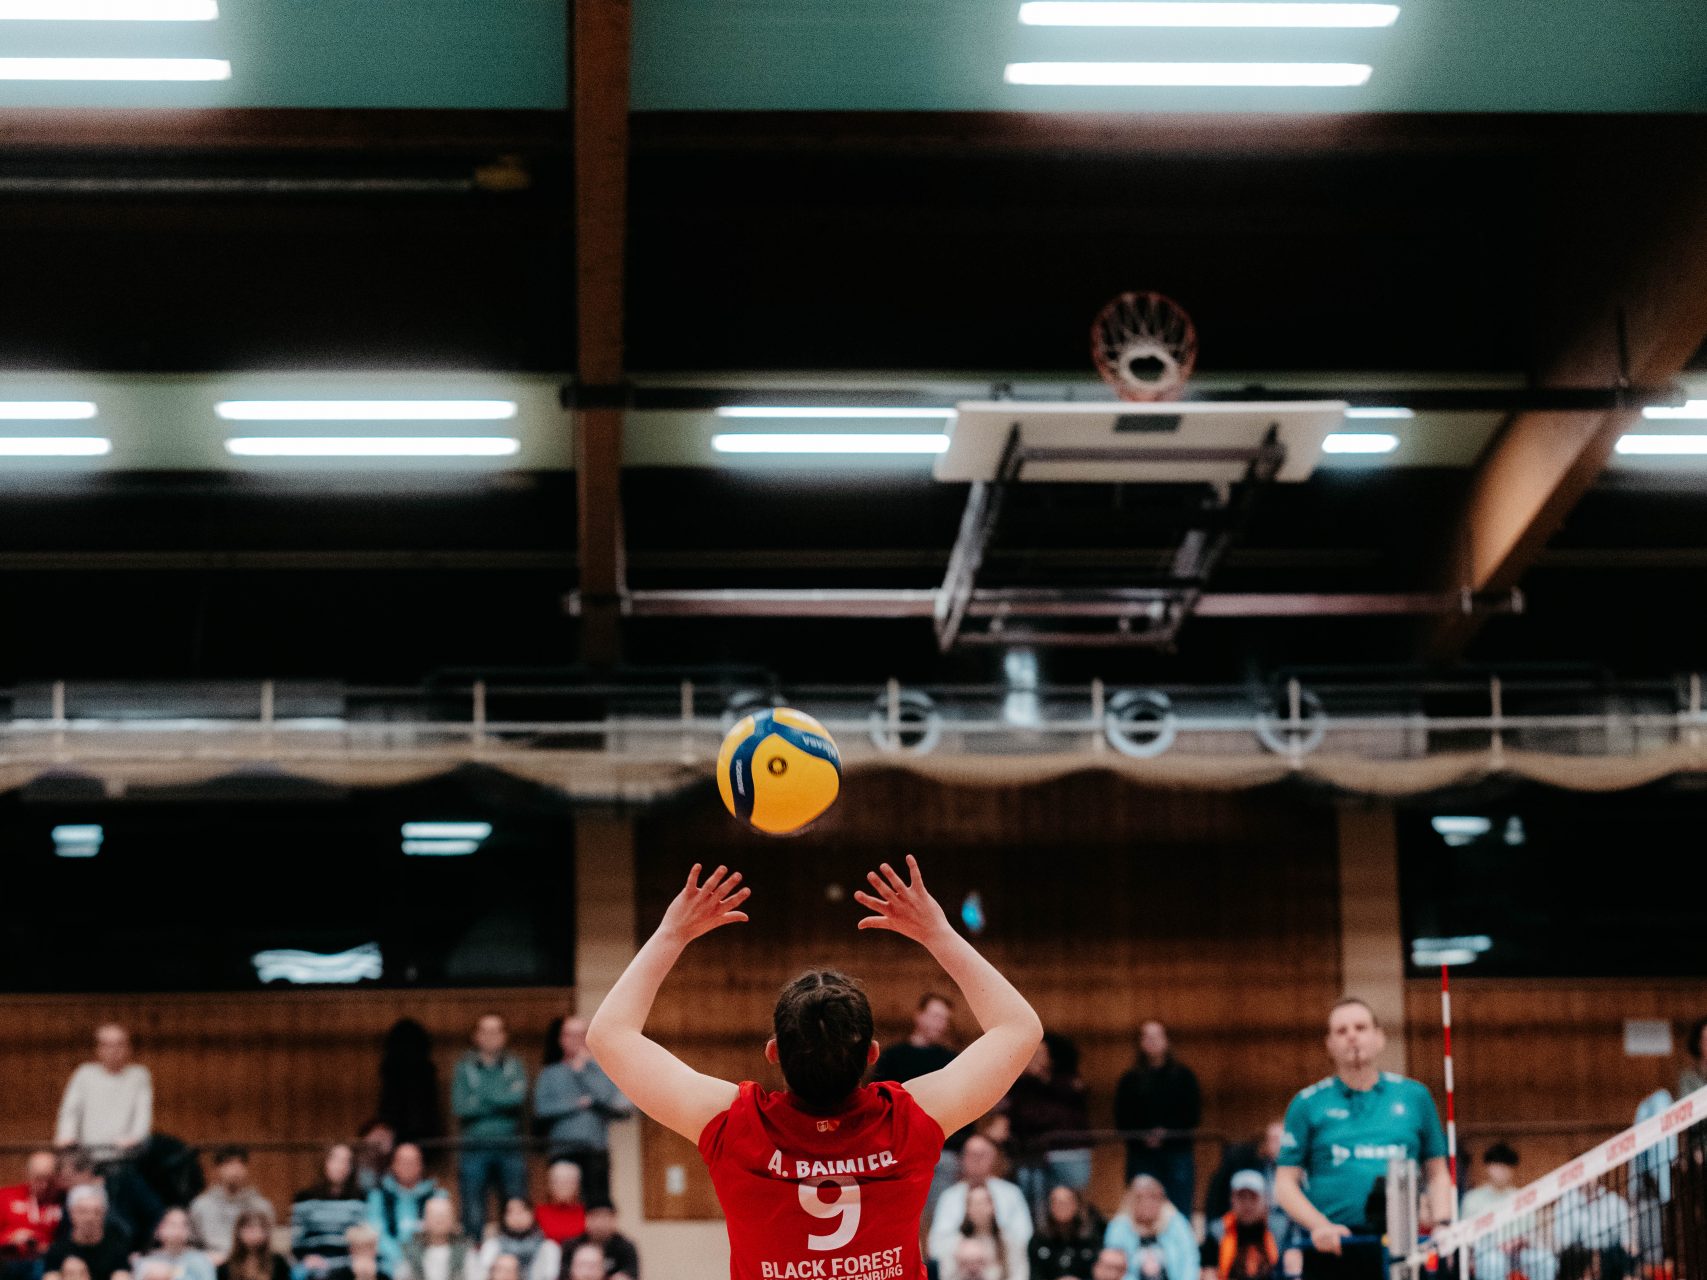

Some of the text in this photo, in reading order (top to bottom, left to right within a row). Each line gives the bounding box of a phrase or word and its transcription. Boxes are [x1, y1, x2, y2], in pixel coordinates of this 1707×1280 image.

[767, 1149, 789, 1178] A.
[798, 1176, 861, 1251] 9
[761, 1246, 903, 1279] BLACK FOREST
